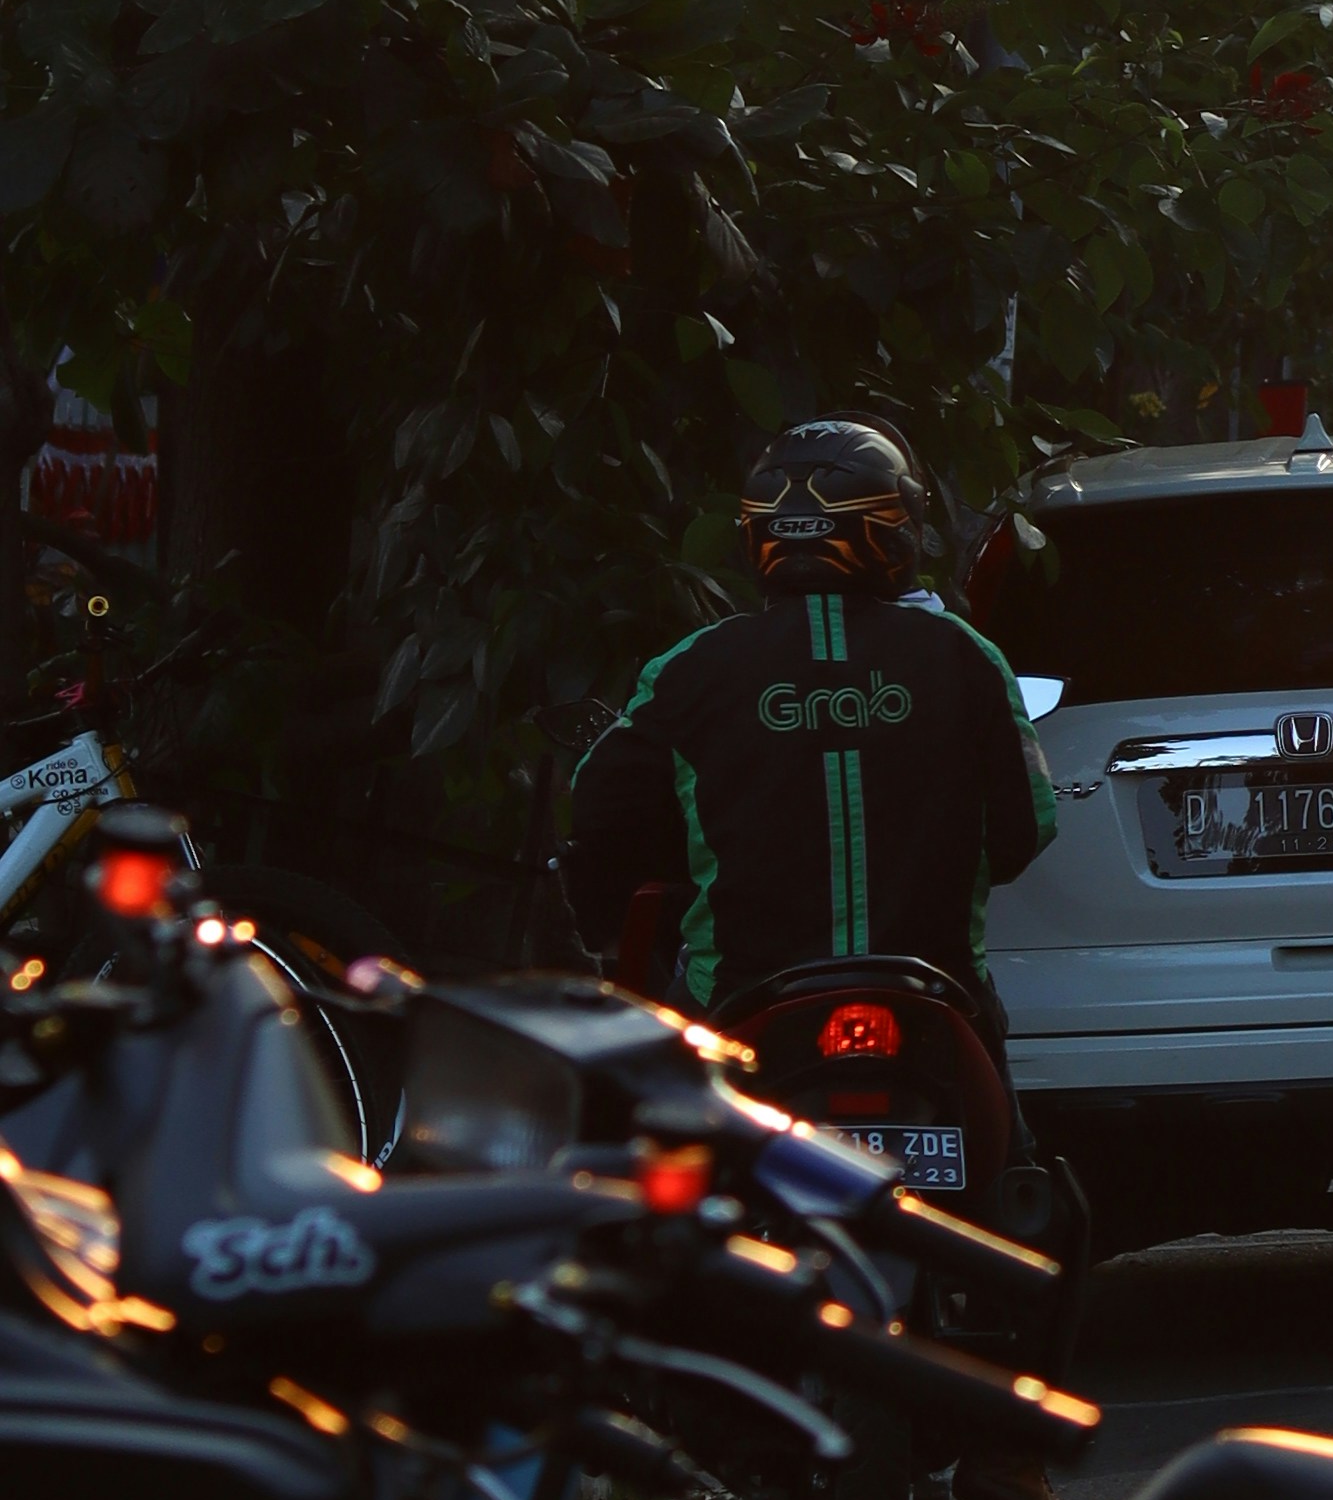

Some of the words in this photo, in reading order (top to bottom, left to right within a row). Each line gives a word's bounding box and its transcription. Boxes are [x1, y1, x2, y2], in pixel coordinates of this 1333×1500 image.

[757, 669, 913, 732] Grab
[28, 768, 88, 789] Kona
[1186, 794, 1207, 836] D
[902, 1132, 958, 1158] ZDE
